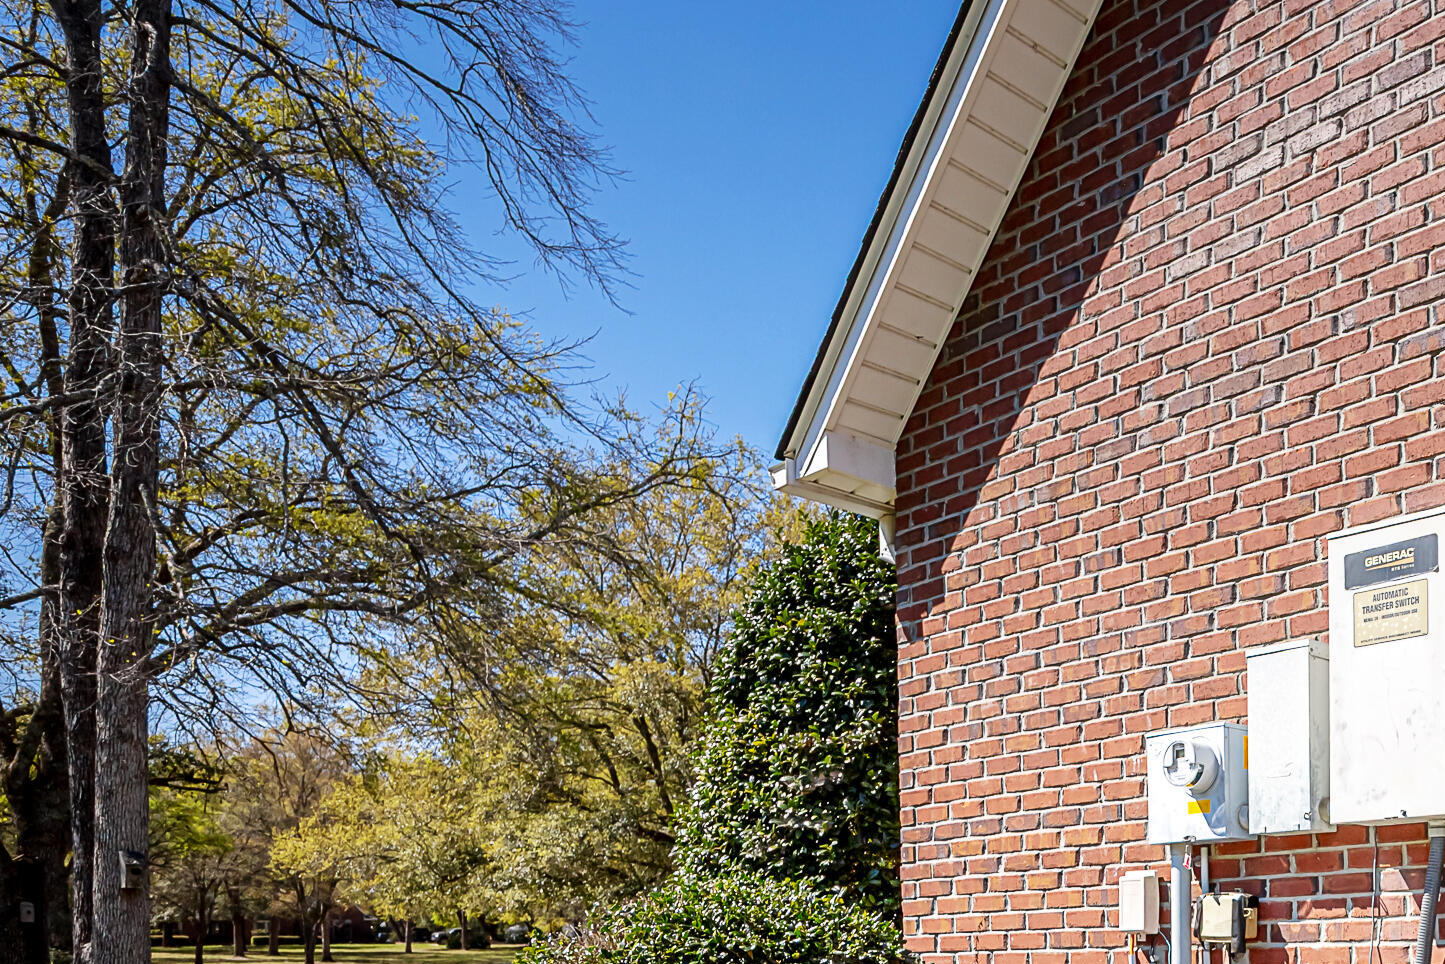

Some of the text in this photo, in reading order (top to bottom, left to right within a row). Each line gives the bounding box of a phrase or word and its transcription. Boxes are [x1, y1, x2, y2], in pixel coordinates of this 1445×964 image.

[1364, 547, 1415, 567] GENERAC
[1373, 588, 1409, 602] AUTOMATIC
[1362, 601, 1394, 614] TRANSFER
[1395, 596, 1420, 608] SWITCH
